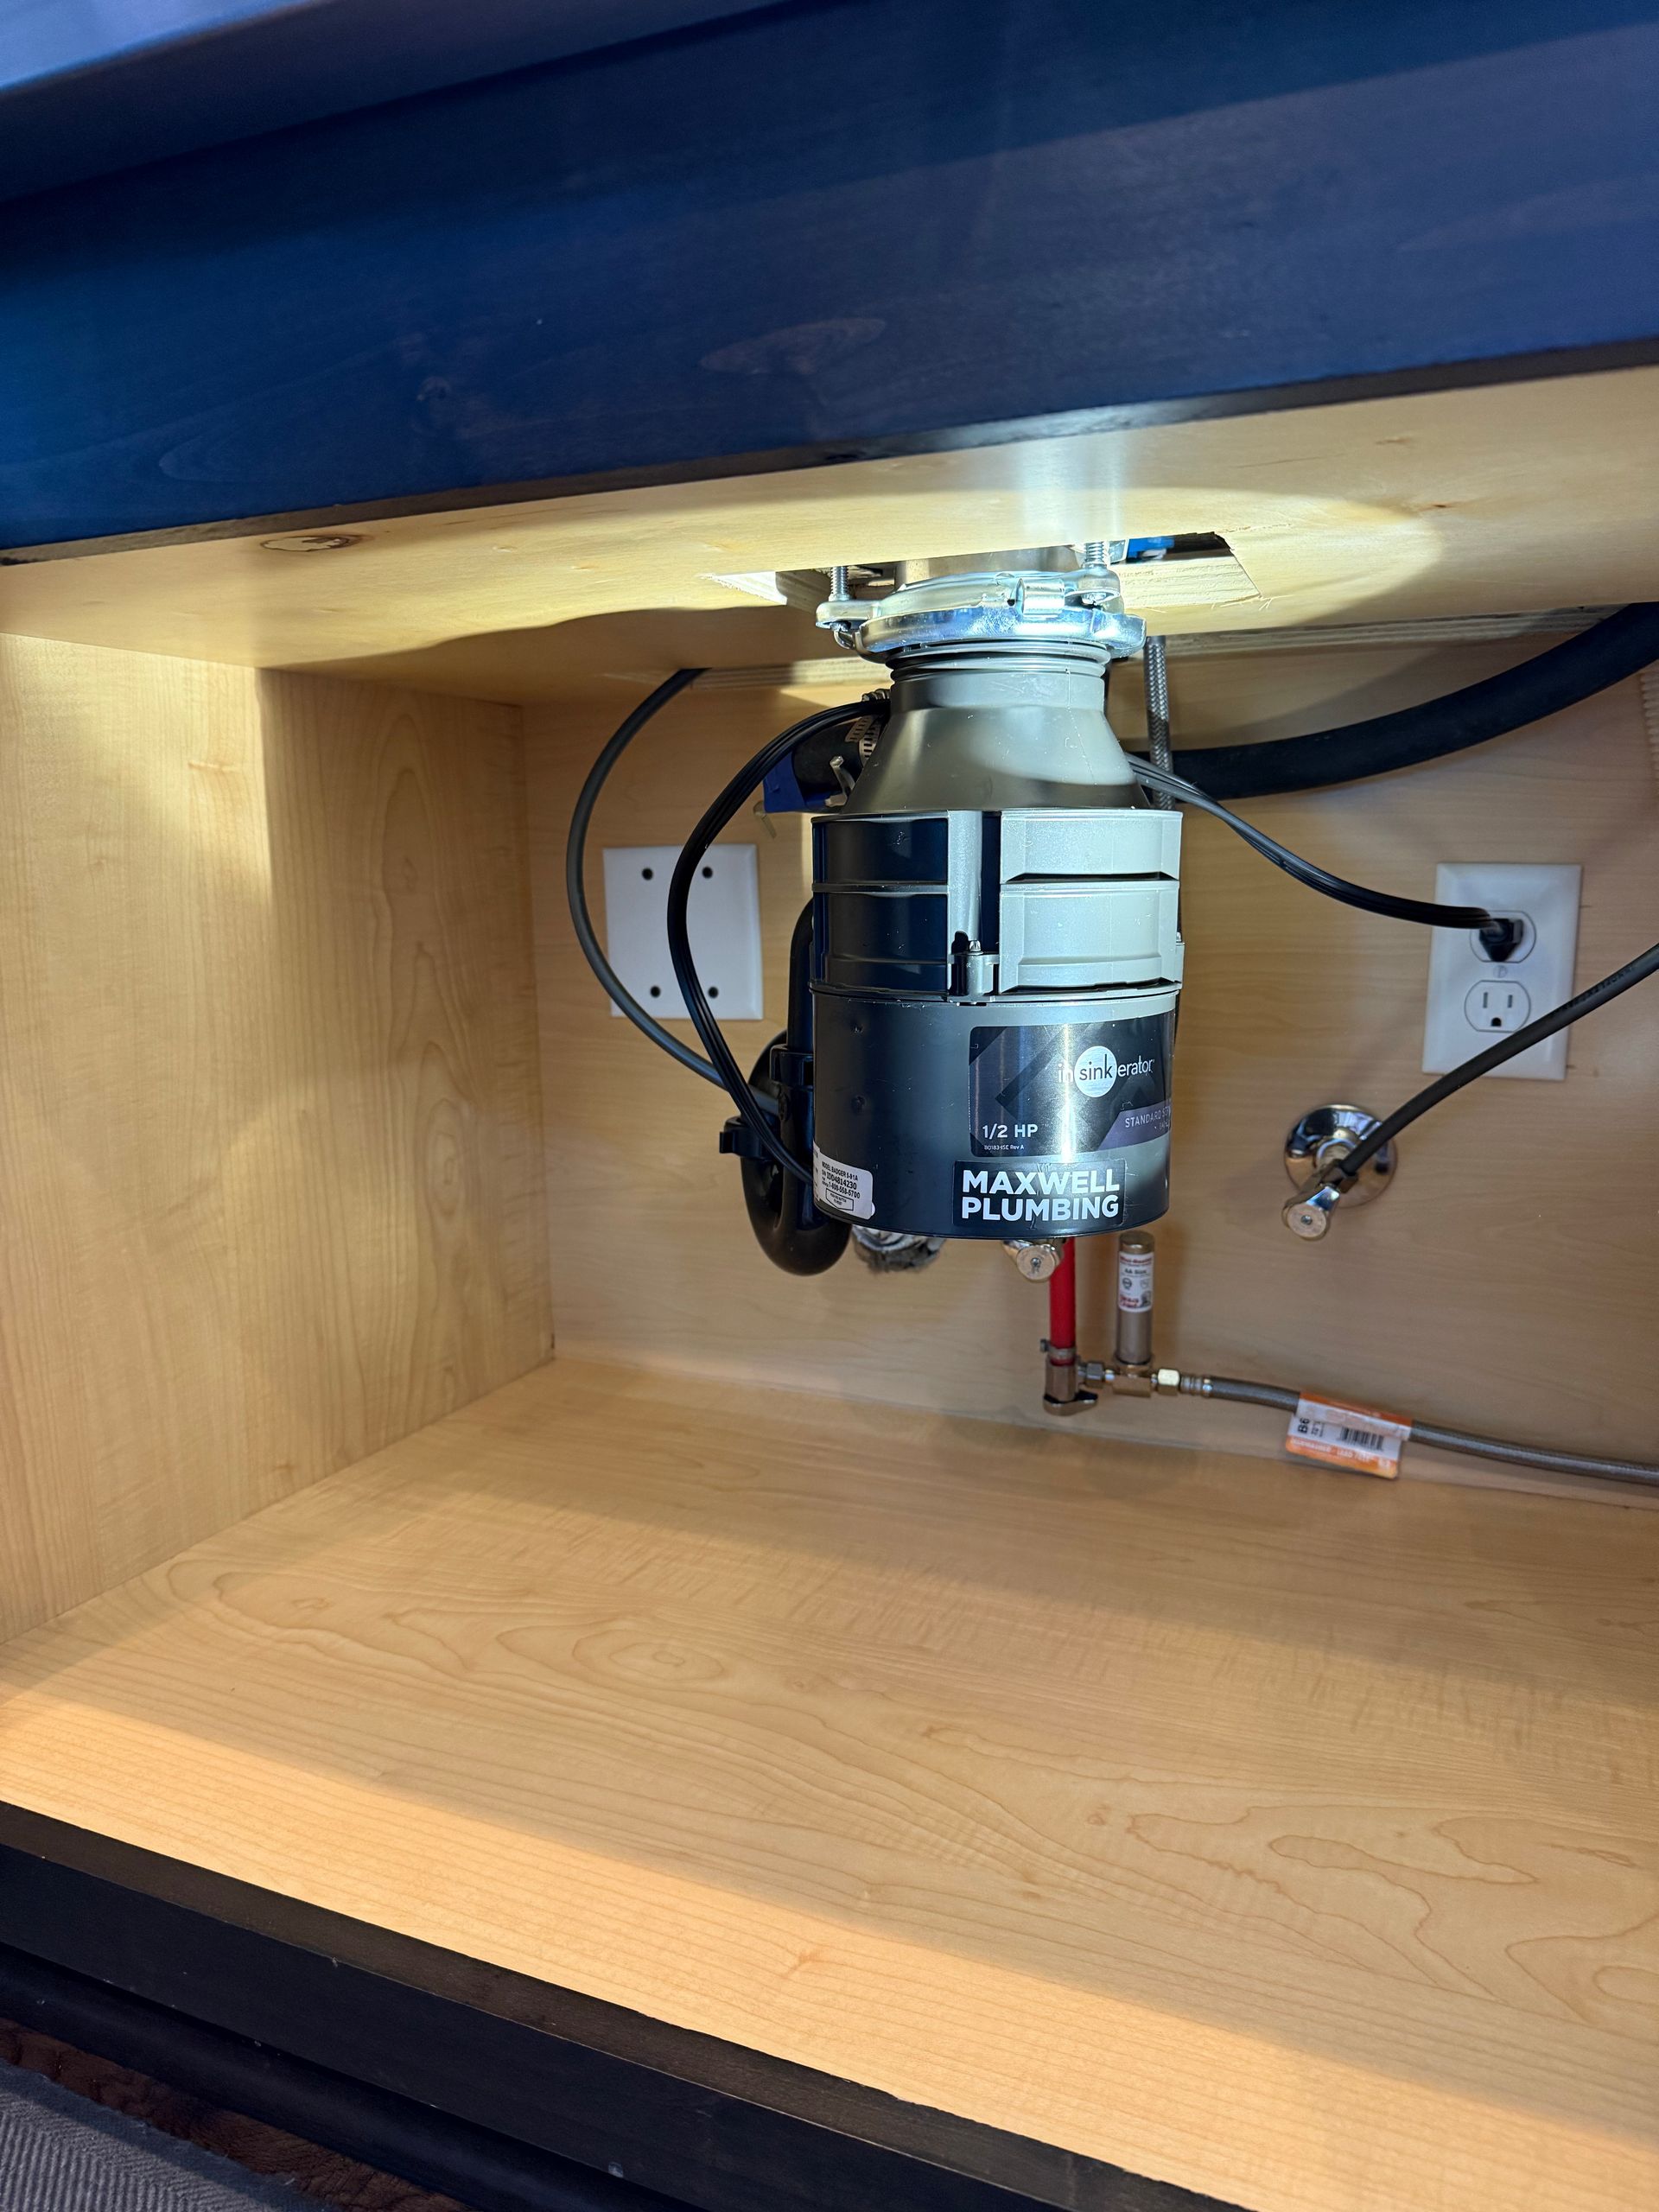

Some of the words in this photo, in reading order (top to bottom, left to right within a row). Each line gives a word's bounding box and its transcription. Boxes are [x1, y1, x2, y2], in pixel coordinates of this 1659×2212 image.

[1125, 1109, 1162, 1128] STANDARD
[982, 1123, 1008, 1140] 1/2
[1014, 1123, 1039, 1138] HP
[831, 1166, 846, 1178] BADGER
[962, 1168, 1121, 1195] MAXWELL
[961, 1194, 1120, 1222] PLUMBING
